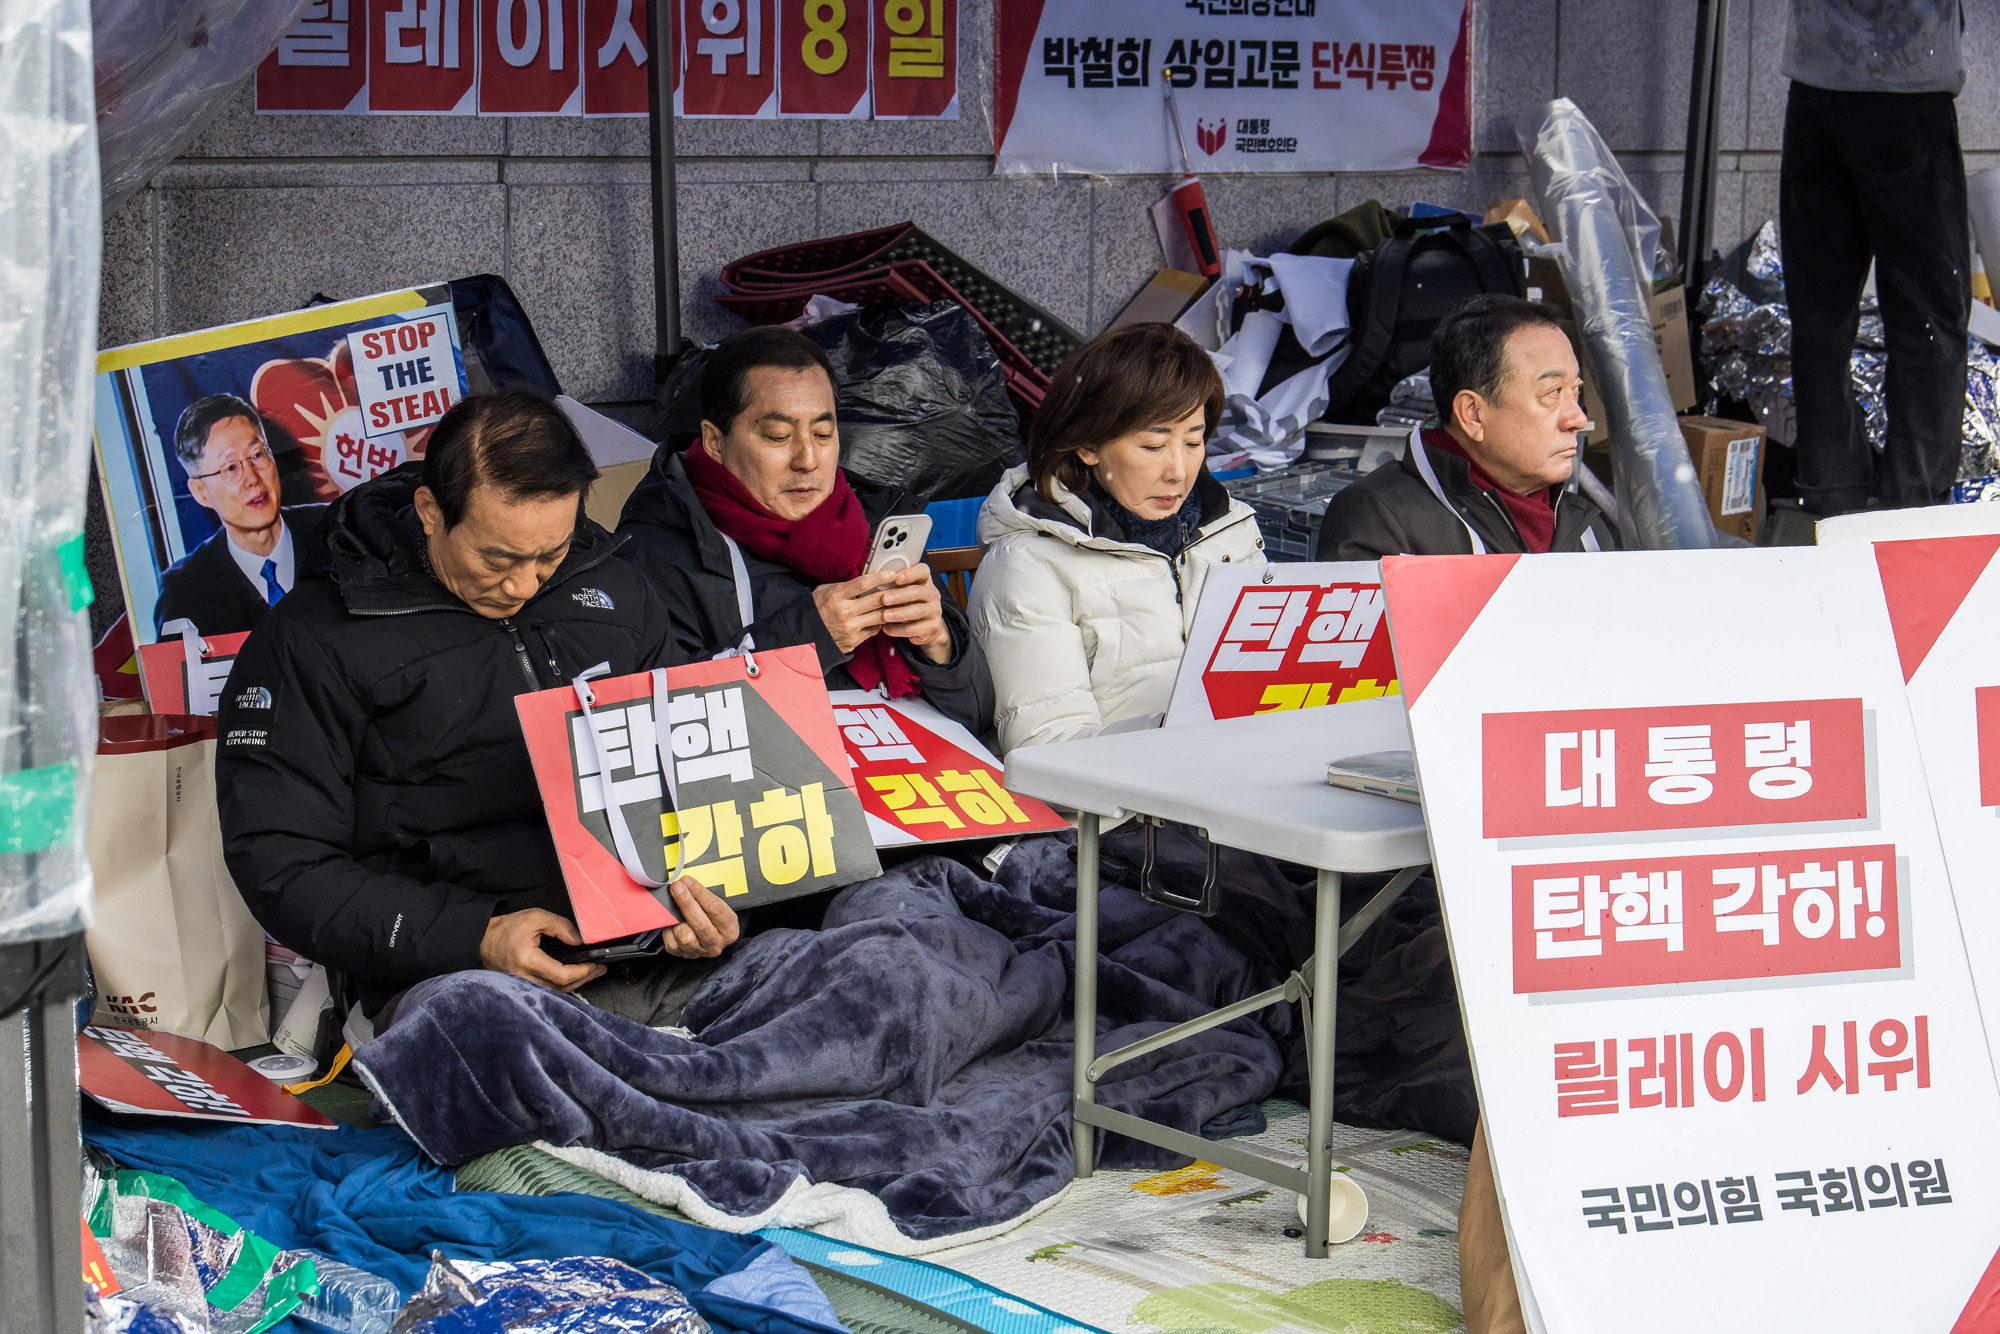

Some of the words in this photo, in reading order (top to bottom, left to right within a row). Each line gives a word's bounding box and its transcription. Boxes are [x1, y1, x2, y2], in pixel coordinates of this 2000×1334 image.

[1043, 37, 1152, 88] 박철희
[1164, 38, 1300, 89] 상임고문
[1312, 41, 1435, 91] 단식투쟁
[1235, 137, 1298, 153] 국민변호인단
[1236, 119, 1270, 134] 대통령
[362, 322, 436, 359] STOP
[377, 356, 435, 391] THE
[582, 600, 601, 608] FACE
[1209, 588, 1386, 669] 탄핵
[226, 738, 267, 746] EXPLORING
[227, 730, 247, 738] NEVER
[248, 730, 268, 738] STOP
[571, 686, 754, 813] 탄핵
[833, 707, 927, 767] 핵
[1545, 720, 1813, 808] 대통령
[865, 769, 1031, 829] 각하
[660, 781, 837, 898] 각하
[389, 913, 403, 948] DRYVENT
[1533, 870, 1684, 960] 탄핵
[1712, 860, 1886, 945] 각하!
[105, 992, 157, 1014] KAC
[113, 1016, 158, 1027] 한국공항공사
[1554, 1027, 1766, 1118] 릴레이
[1796, 1015, 1931, 1095] 시위
[1581, 1175, 1764, 1234] 국민의힘
[1775, 1158, 1953, 1216] 국회의원
